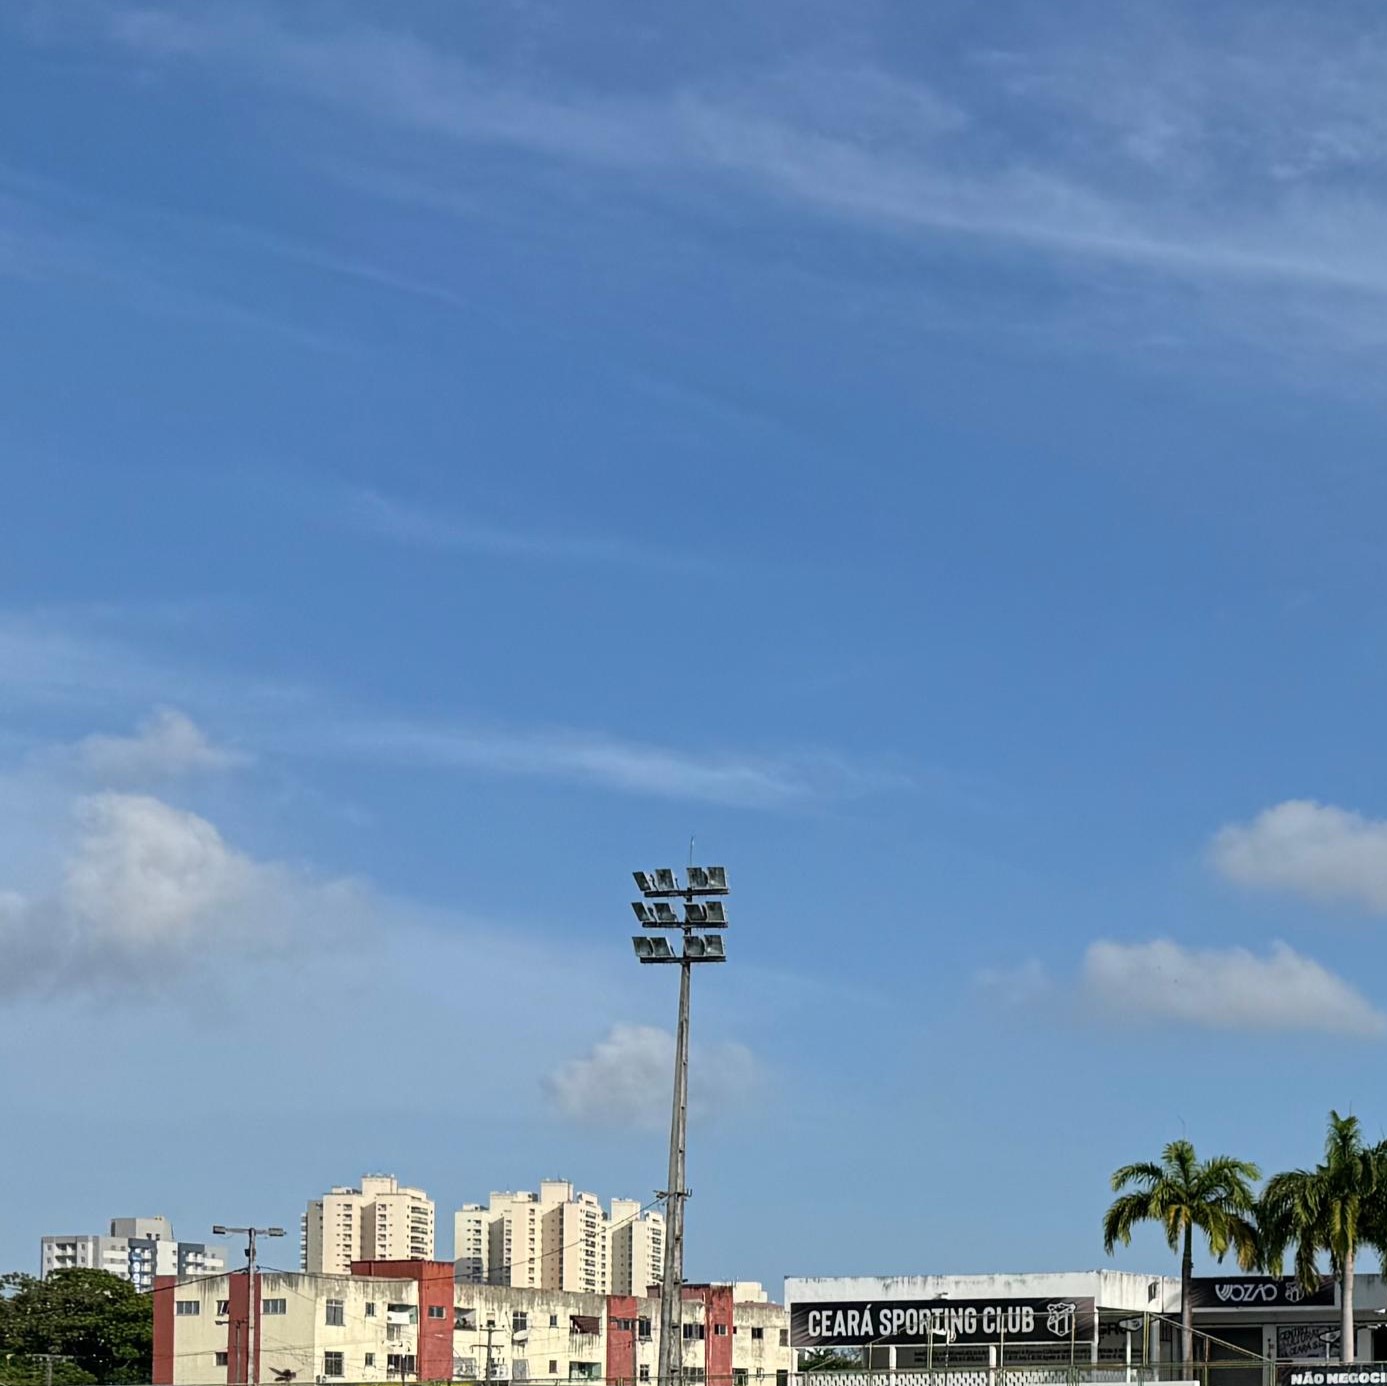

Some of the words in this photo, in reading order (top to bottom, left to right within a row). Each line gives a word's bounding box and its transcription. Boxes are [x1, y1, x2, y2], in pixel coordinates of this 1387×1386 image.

[808, 1304, 873, 1337] CEARÁ
[879, 1307, 976, 1336] SPORTING
[982, 1306, 1035, 1333] CLUB
[1291, 1370, 1324, 1385] NÃO
